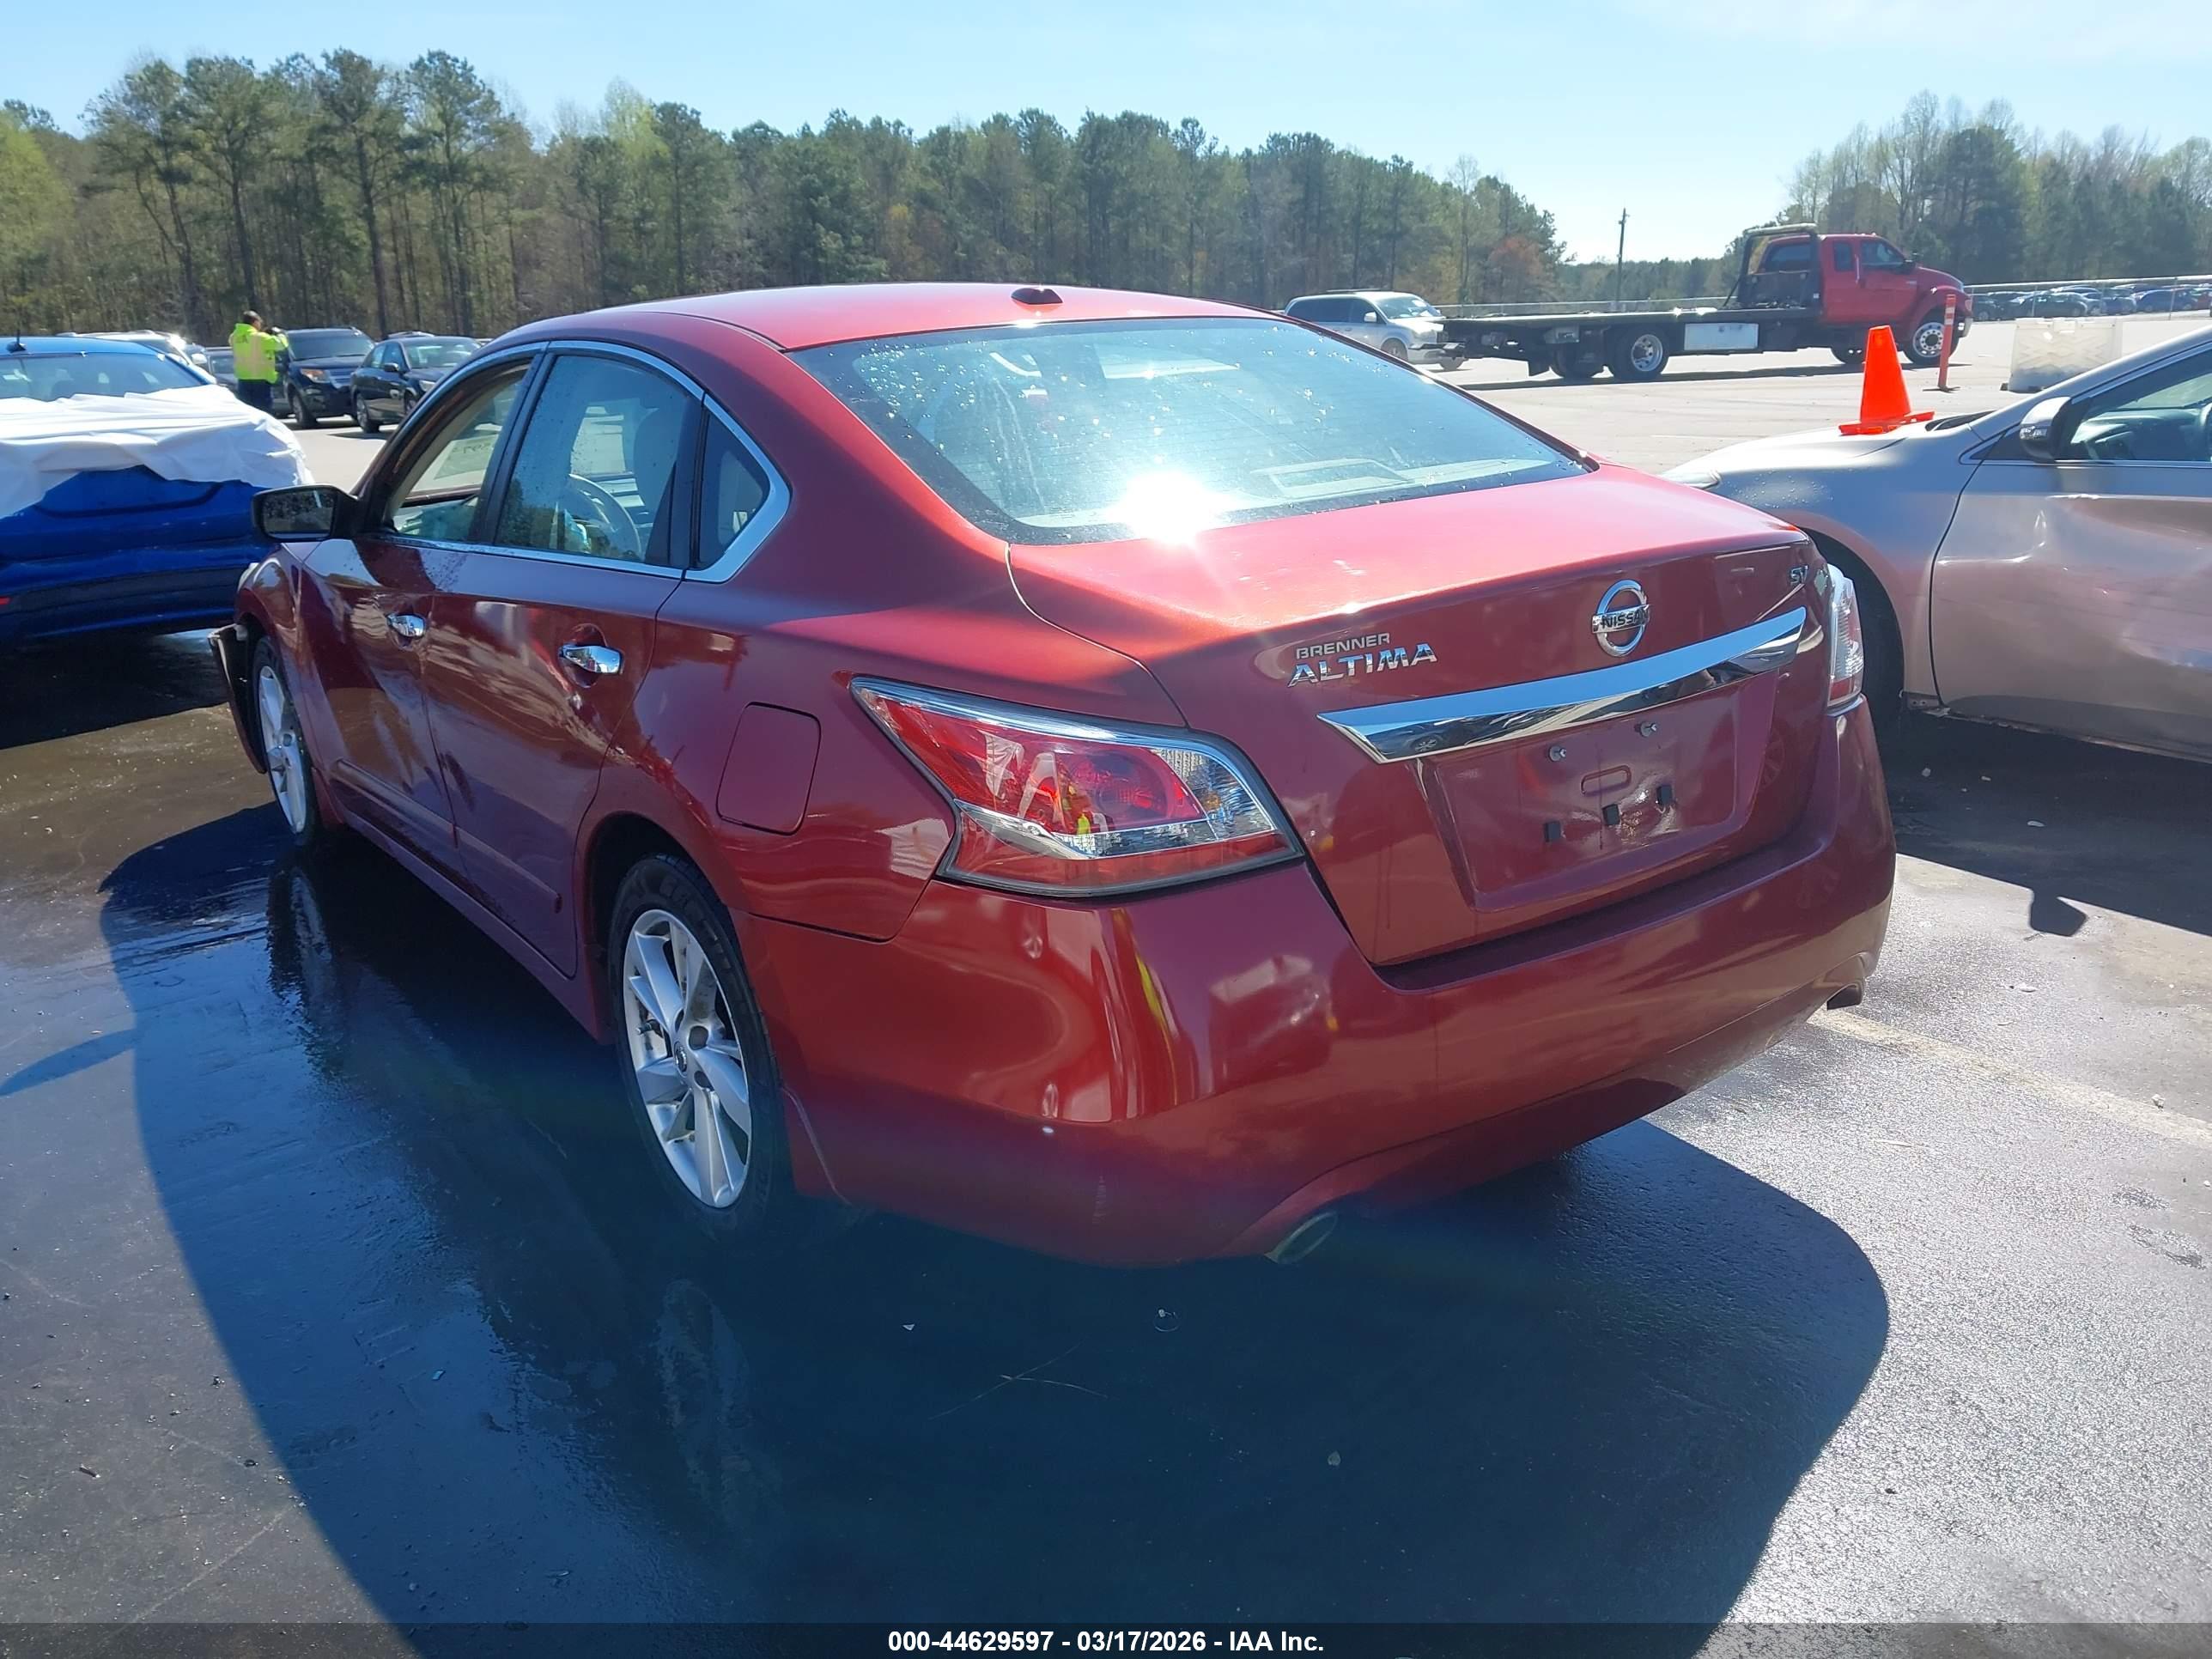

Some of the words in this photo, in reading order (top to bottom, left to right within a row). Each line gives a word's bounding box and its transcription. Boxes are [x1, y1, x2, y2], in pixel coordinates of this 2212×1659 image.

[1600, 608, 1649, 629] NISSAN
[1296, 632, 1390, 659] BRENNER
[1287, 643, 1438, 687] ALTIMA
